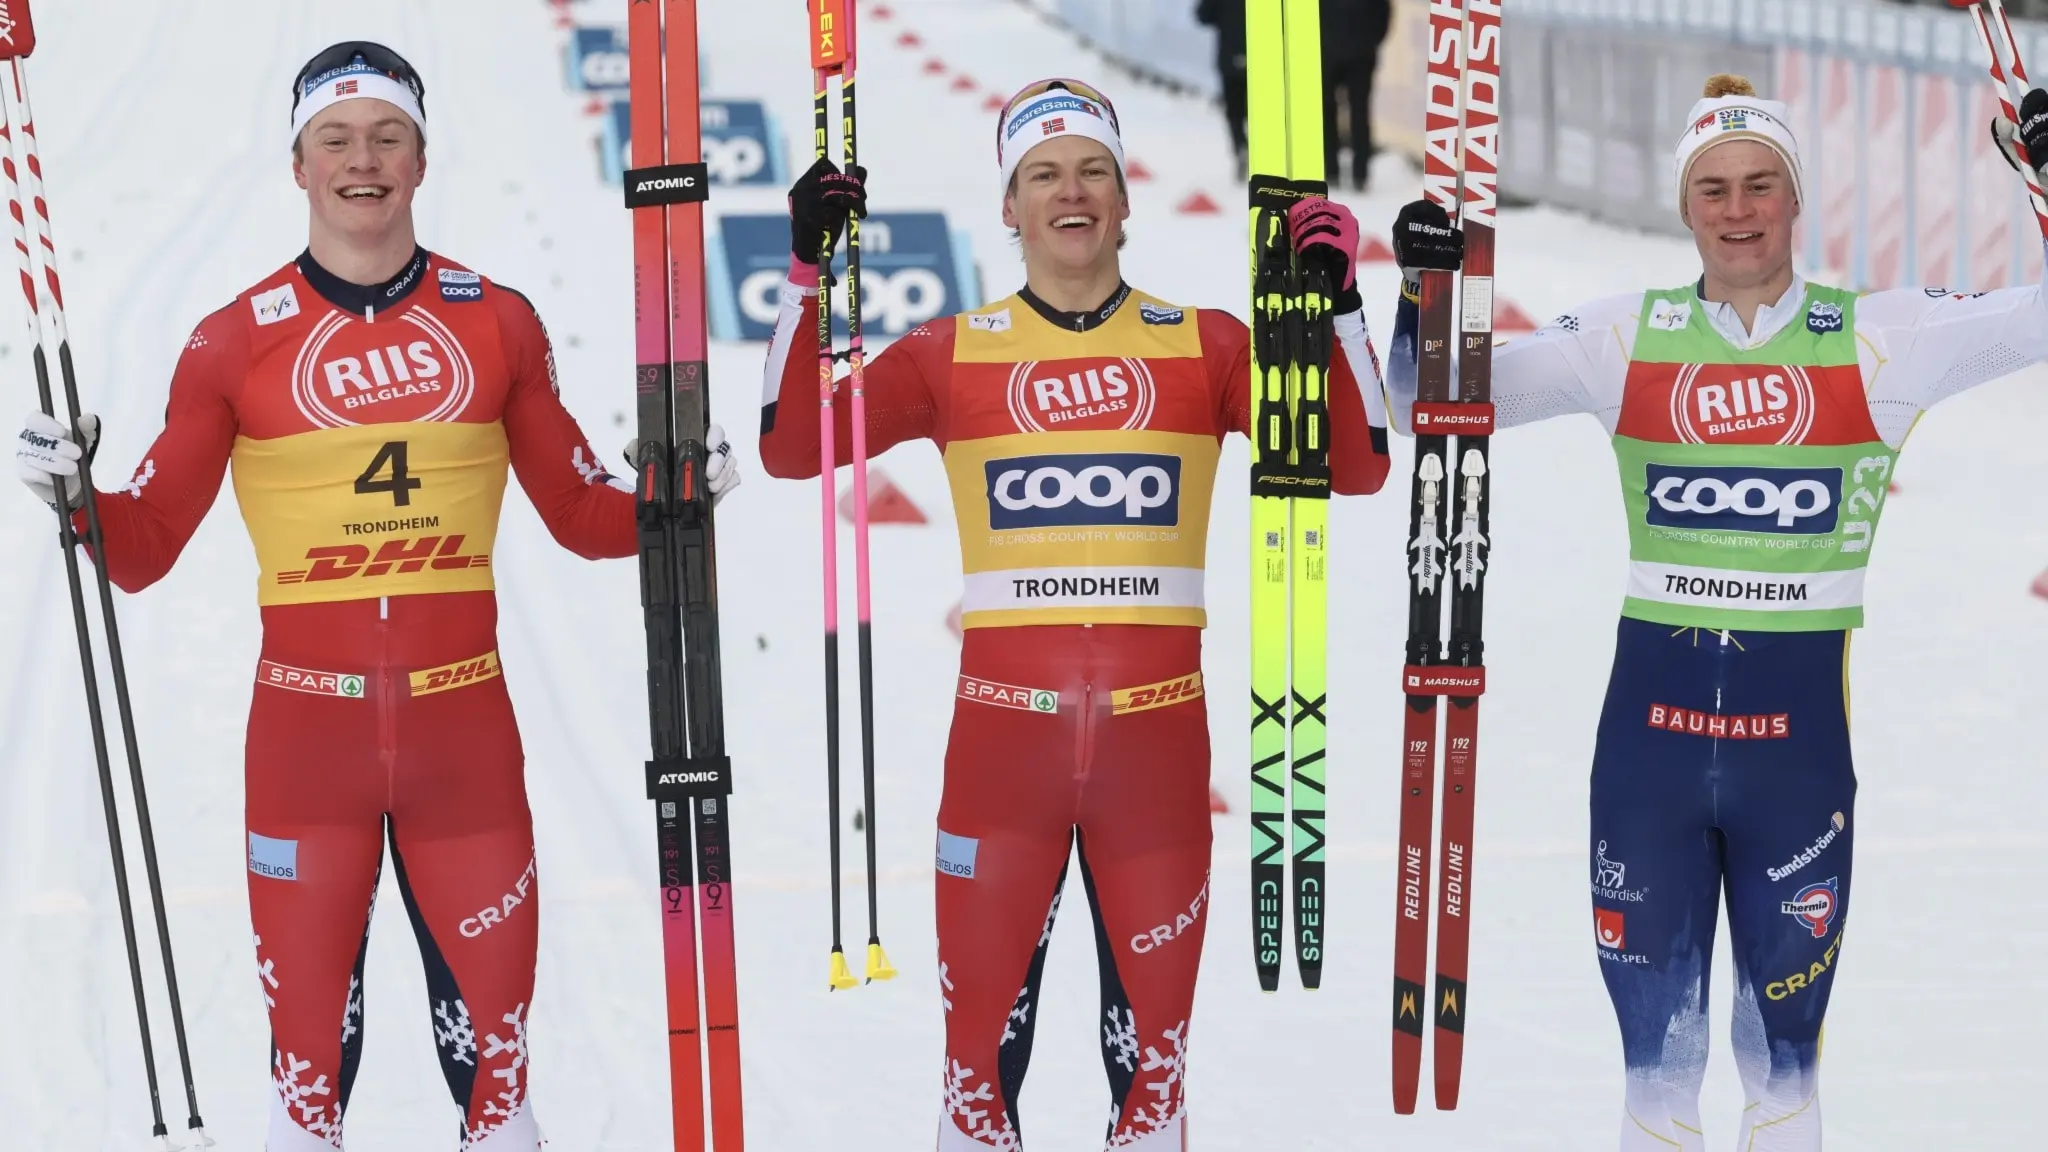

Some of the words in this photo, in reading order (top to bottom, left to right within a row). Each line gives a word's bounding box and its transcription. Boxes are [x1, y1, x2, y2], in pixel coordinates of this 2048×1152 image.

[1008, 101, 1081, 135] SpareBank
[1424, 0, 1463, 225] MADS
[1718, 109, 1772, 123] SVENSKA
[636, 176, 695, 193] ATOMIC
[820, 173, 862, 186] HESTRA
[1256, 187, 1326, 199] FISCHER
[386, 263, 420, 297] CRAFT
[442, 286, 481, 298] coop
[1101, 289, 1128, 320] CRAFT
[323, 341, 441, 397] RIIS
[637, 368, 658, 384] S9
[676, 364, 697, 382] S9
[343, 380, 441, 409] BILGLASS
[1033, 365, 1129, 411] RIIS
[1696, 374, 1788, 423] RIIS
[1048, 400, 1128, 423] BILGLASS
[1433, 415, 1490, 424] MADSHUS
[1708, 413, 1786, 435] BILGLASS
[354, 440, 421, 507] 4
[1257, 475, 1329, 486] FISCHER
[993, 465, 1172, 518] coop
[1650, 476, 1830, 527] coop
[1840, 455, 1891, 553] U23
[342, 515, 440, 536] TRONDHEIM
[1006, 532, 1044, 544] CROSS
[1048, 531, 1109, 543] COUNTRY
[1115, 531, 1157, 542] WORLD
[1159, 532, 1179, 541] CUP
[1701, 533, 1761, 547] COUNTRY
[1765, 538, 1808, 549] WORLD
[1811, 539, 1836, 548] CUP
[304, 534, 474, 583] DHL
[1012, 577, 1160, 598] TRONDHEIM
[1664, 574, 1808, 601] TRONDHEIM
[269, 667, 336, 691] SPAR
[425, 659, 492, 690] DHL
[1424, 677, 1480, 687] MADSHUS
[965, 681, 1029, 705] SPAR
[1127, 678, 1197, 709] DHL
[1651, 706, 1788, 736] BAUHAUS
[1410, 740, 1428, 752] 192
[1452, 737, 1470, 749] 192
[658, 771, 719, 784] ATOMIC
[663, 849, 679, 859] 191
[704, 846, 719, 856] 191
[1766, 829, 1836, 882] Sundström
[250, 858, 294, 877] ENTELIOS
[1404, 845, 1421, 921] REDLINE
[1446, 842, 1464, 918] REDLINE
[459, 862, 536, 938] CRAFT
[1601, 887, 1644, 902] nordisk
[1130, 884, 1209, 954] CRAFT
[1783, 900, 1828, 914] Thermia
[1260, 880, 1277, 964] SPEED
[1302, 878, 1319, 961] SPEED
[1622, 954, 1650, 964] SPEL
[1765, 930, 1842, 1001] CRAFT
